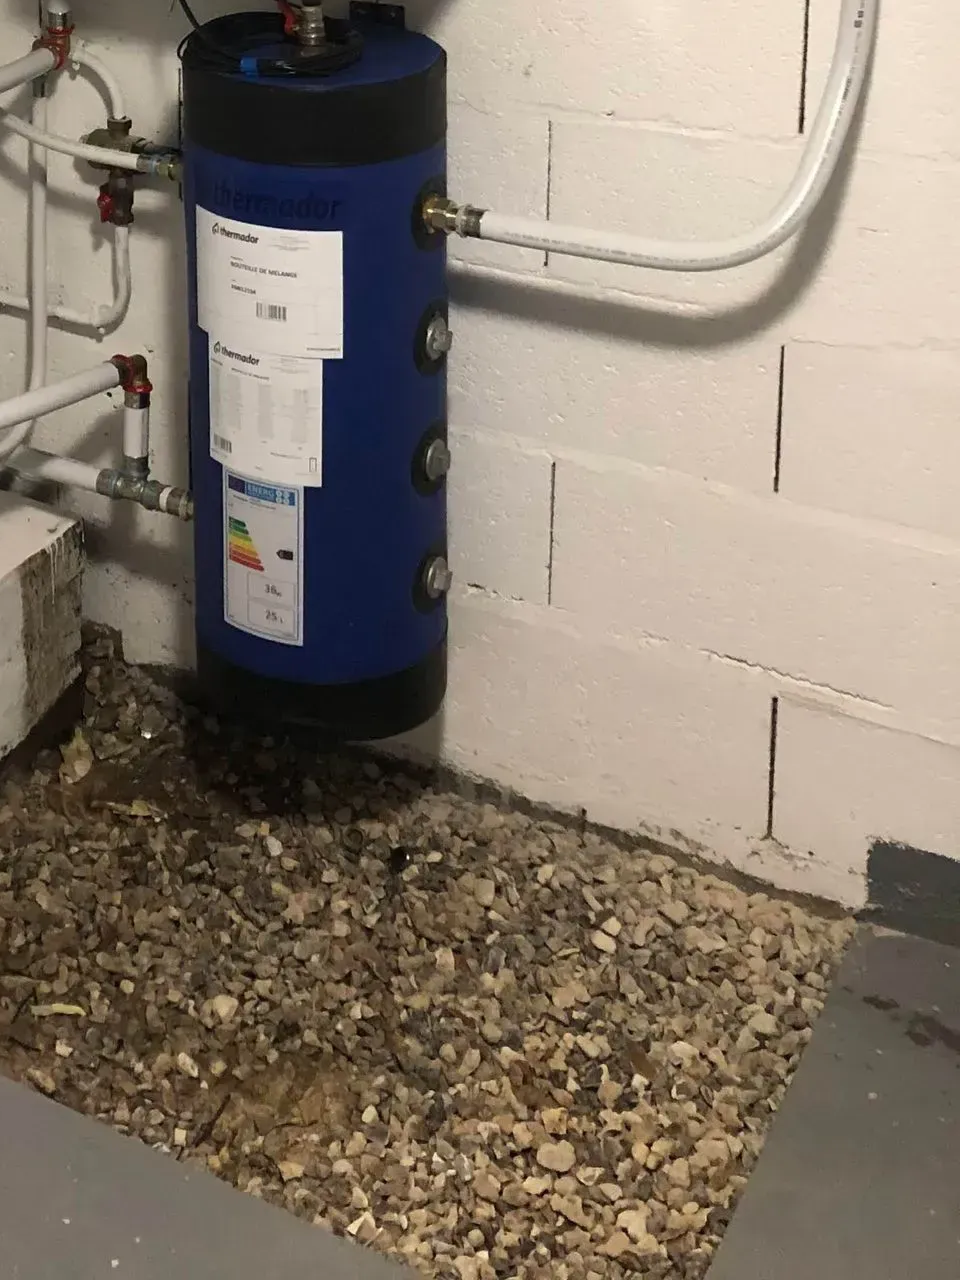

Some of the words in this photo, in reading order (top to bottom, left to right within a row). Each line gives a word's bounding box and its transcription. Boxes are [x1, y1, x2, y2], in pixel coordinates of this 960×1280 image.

[213, 179, 342, 220] thermador
[220, 227, 259, 244] thermador
[221, 346, 260, 366] thermador
